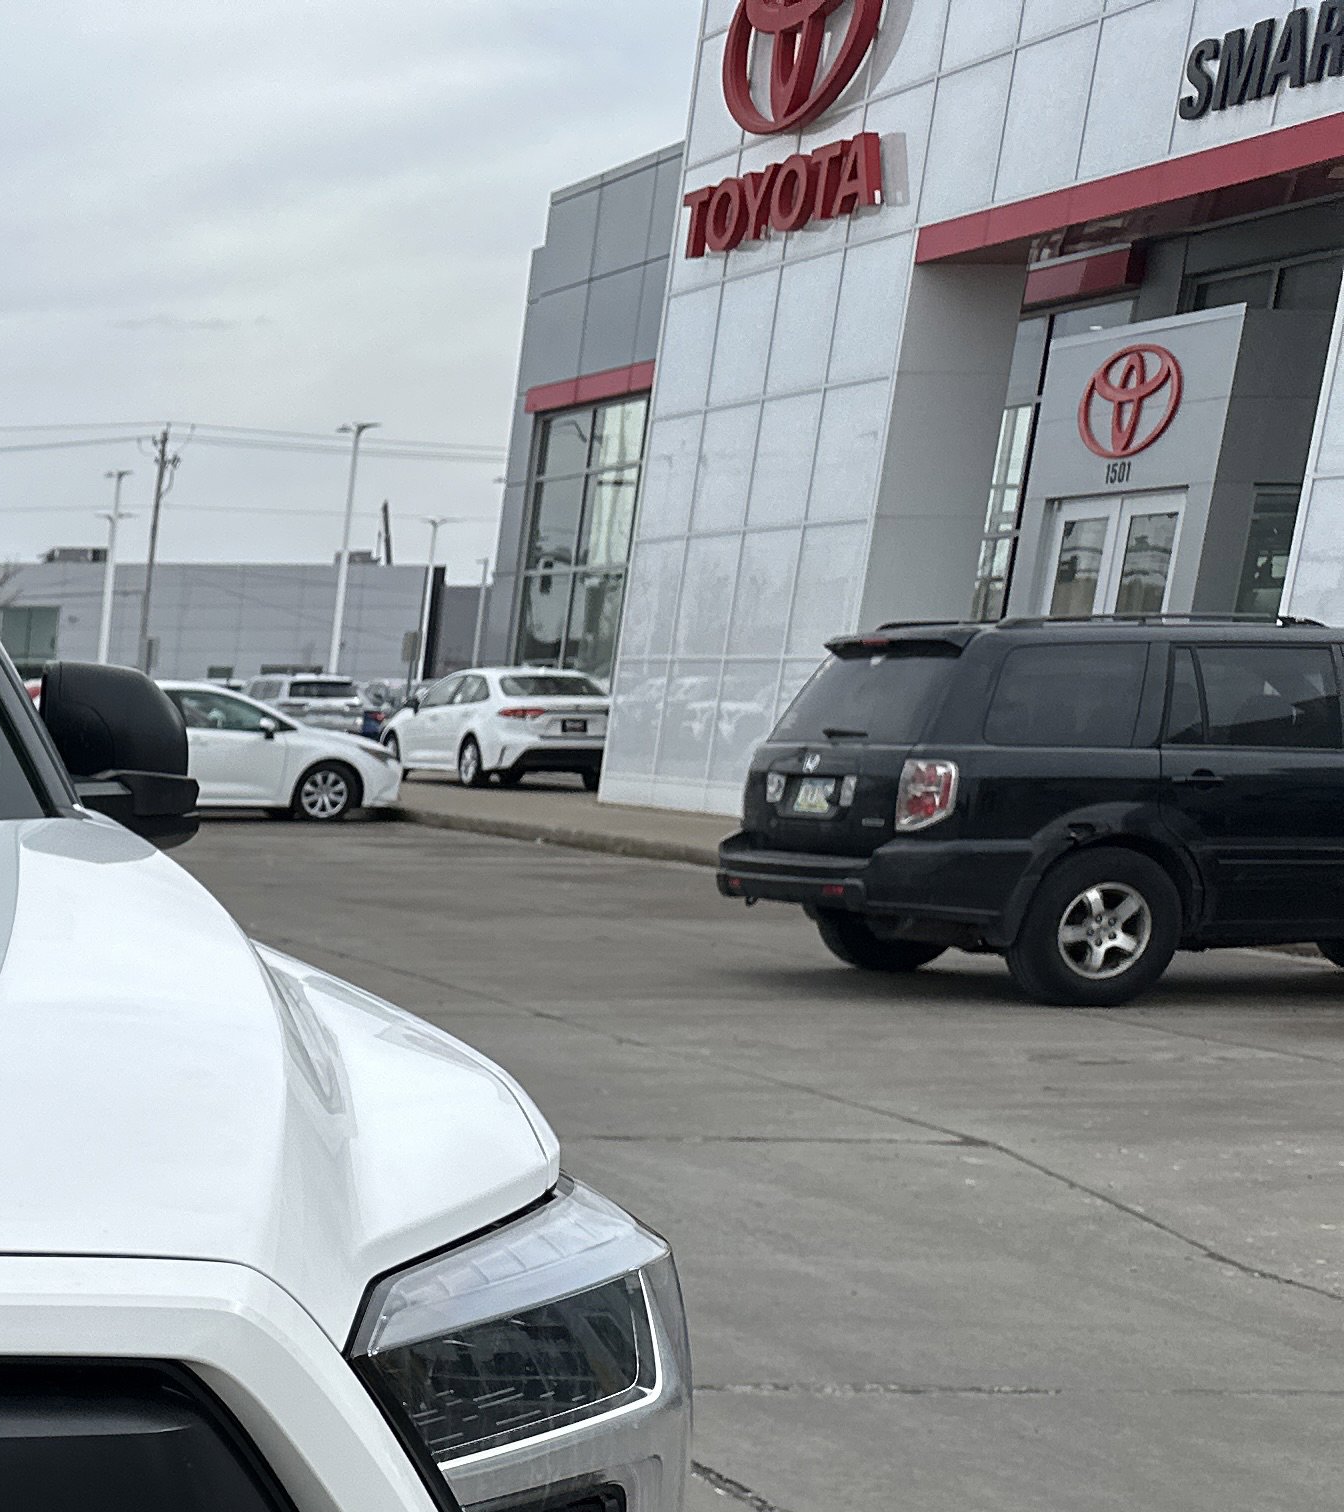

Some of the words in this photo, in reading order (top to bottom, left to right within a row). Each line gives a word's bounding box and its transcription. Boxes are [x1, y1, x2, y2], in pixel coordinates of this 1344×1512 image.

[1179, 0, 1344, 120] SMAR
[683, 131, 882, 259] TOYOTA
[1105, 461, 1132, 485] 1501
